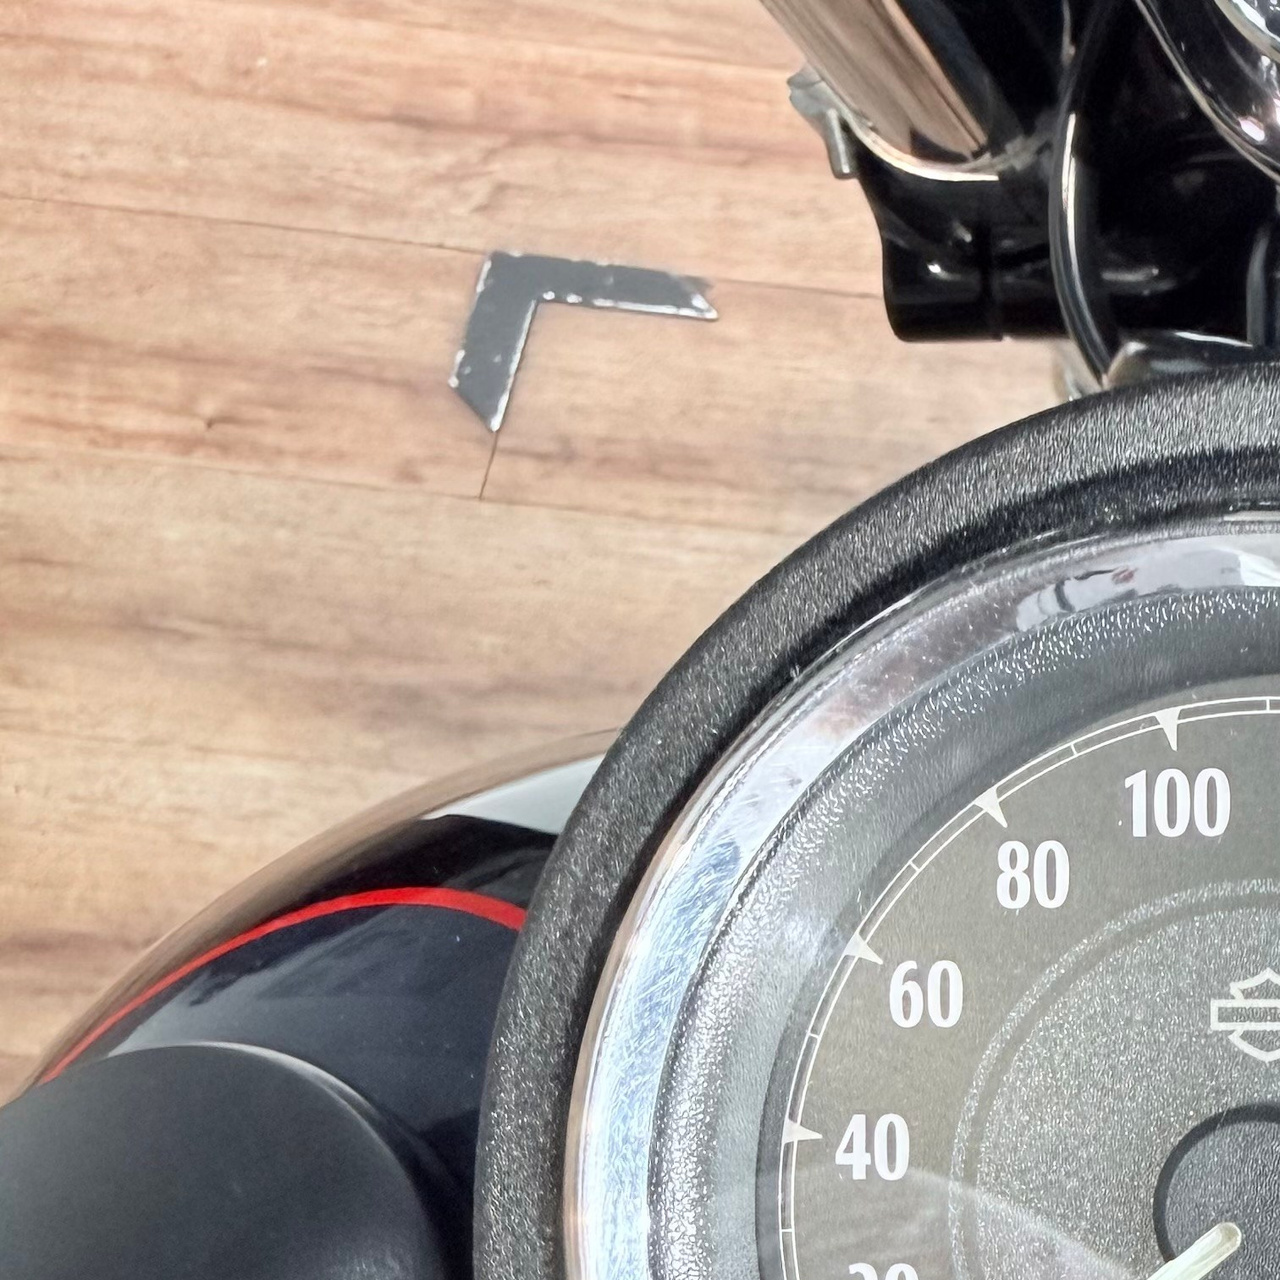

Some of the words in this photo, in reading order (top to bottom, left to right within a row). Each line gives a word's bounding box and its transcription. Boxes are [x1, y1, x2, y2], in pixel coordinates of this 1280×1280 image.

[1124, 767, 1231, 838] 100
[996, 839, 1071, 909] 80
[888, 959, 964, 1029] 60
[834, 1113, 910, 1181] 40
